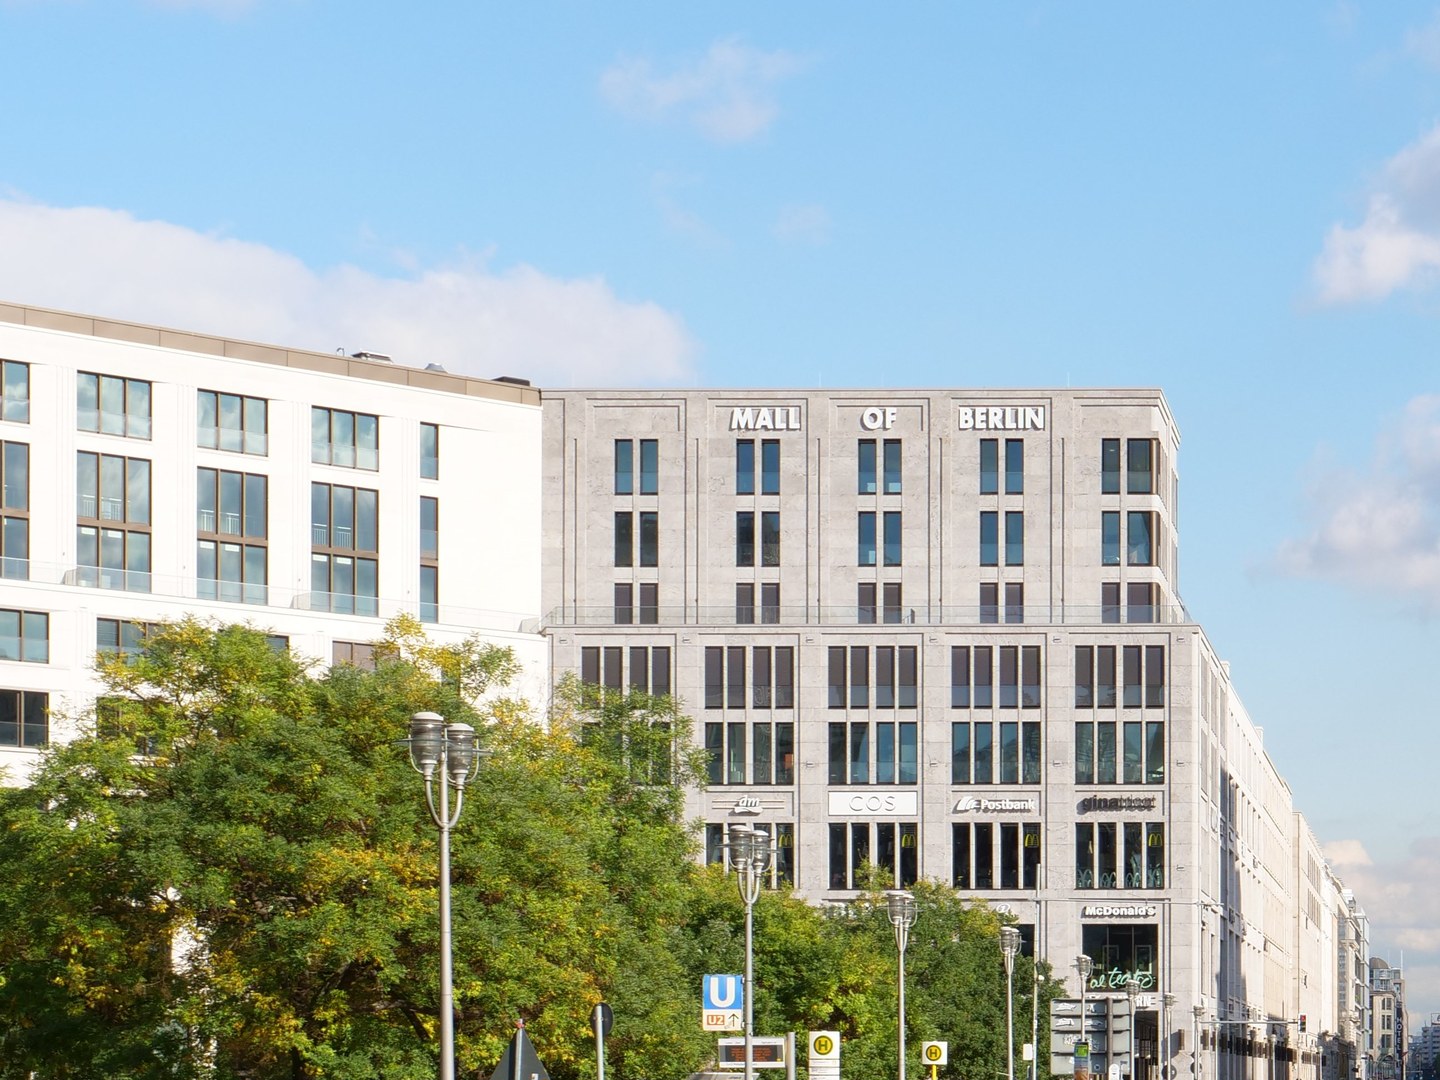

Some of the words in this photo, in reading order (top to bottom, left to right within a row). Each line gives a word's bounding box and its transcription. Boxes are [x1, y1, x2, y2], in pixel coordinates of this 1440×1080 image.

[731, 408, 801, 430] MALL
[861, 407, 897, 430] OF
[959, 407, 1045, 429] BERLIN
[738, 795, 760, 807] dm
[849, 796, 897, 812] COS
[980, 798, 1036, 811] Postbank
[1085, 906, 1155, 916] McDonald's
[710, 976, 736, 1008] U
[708, 1016, 724, 1025] U2
